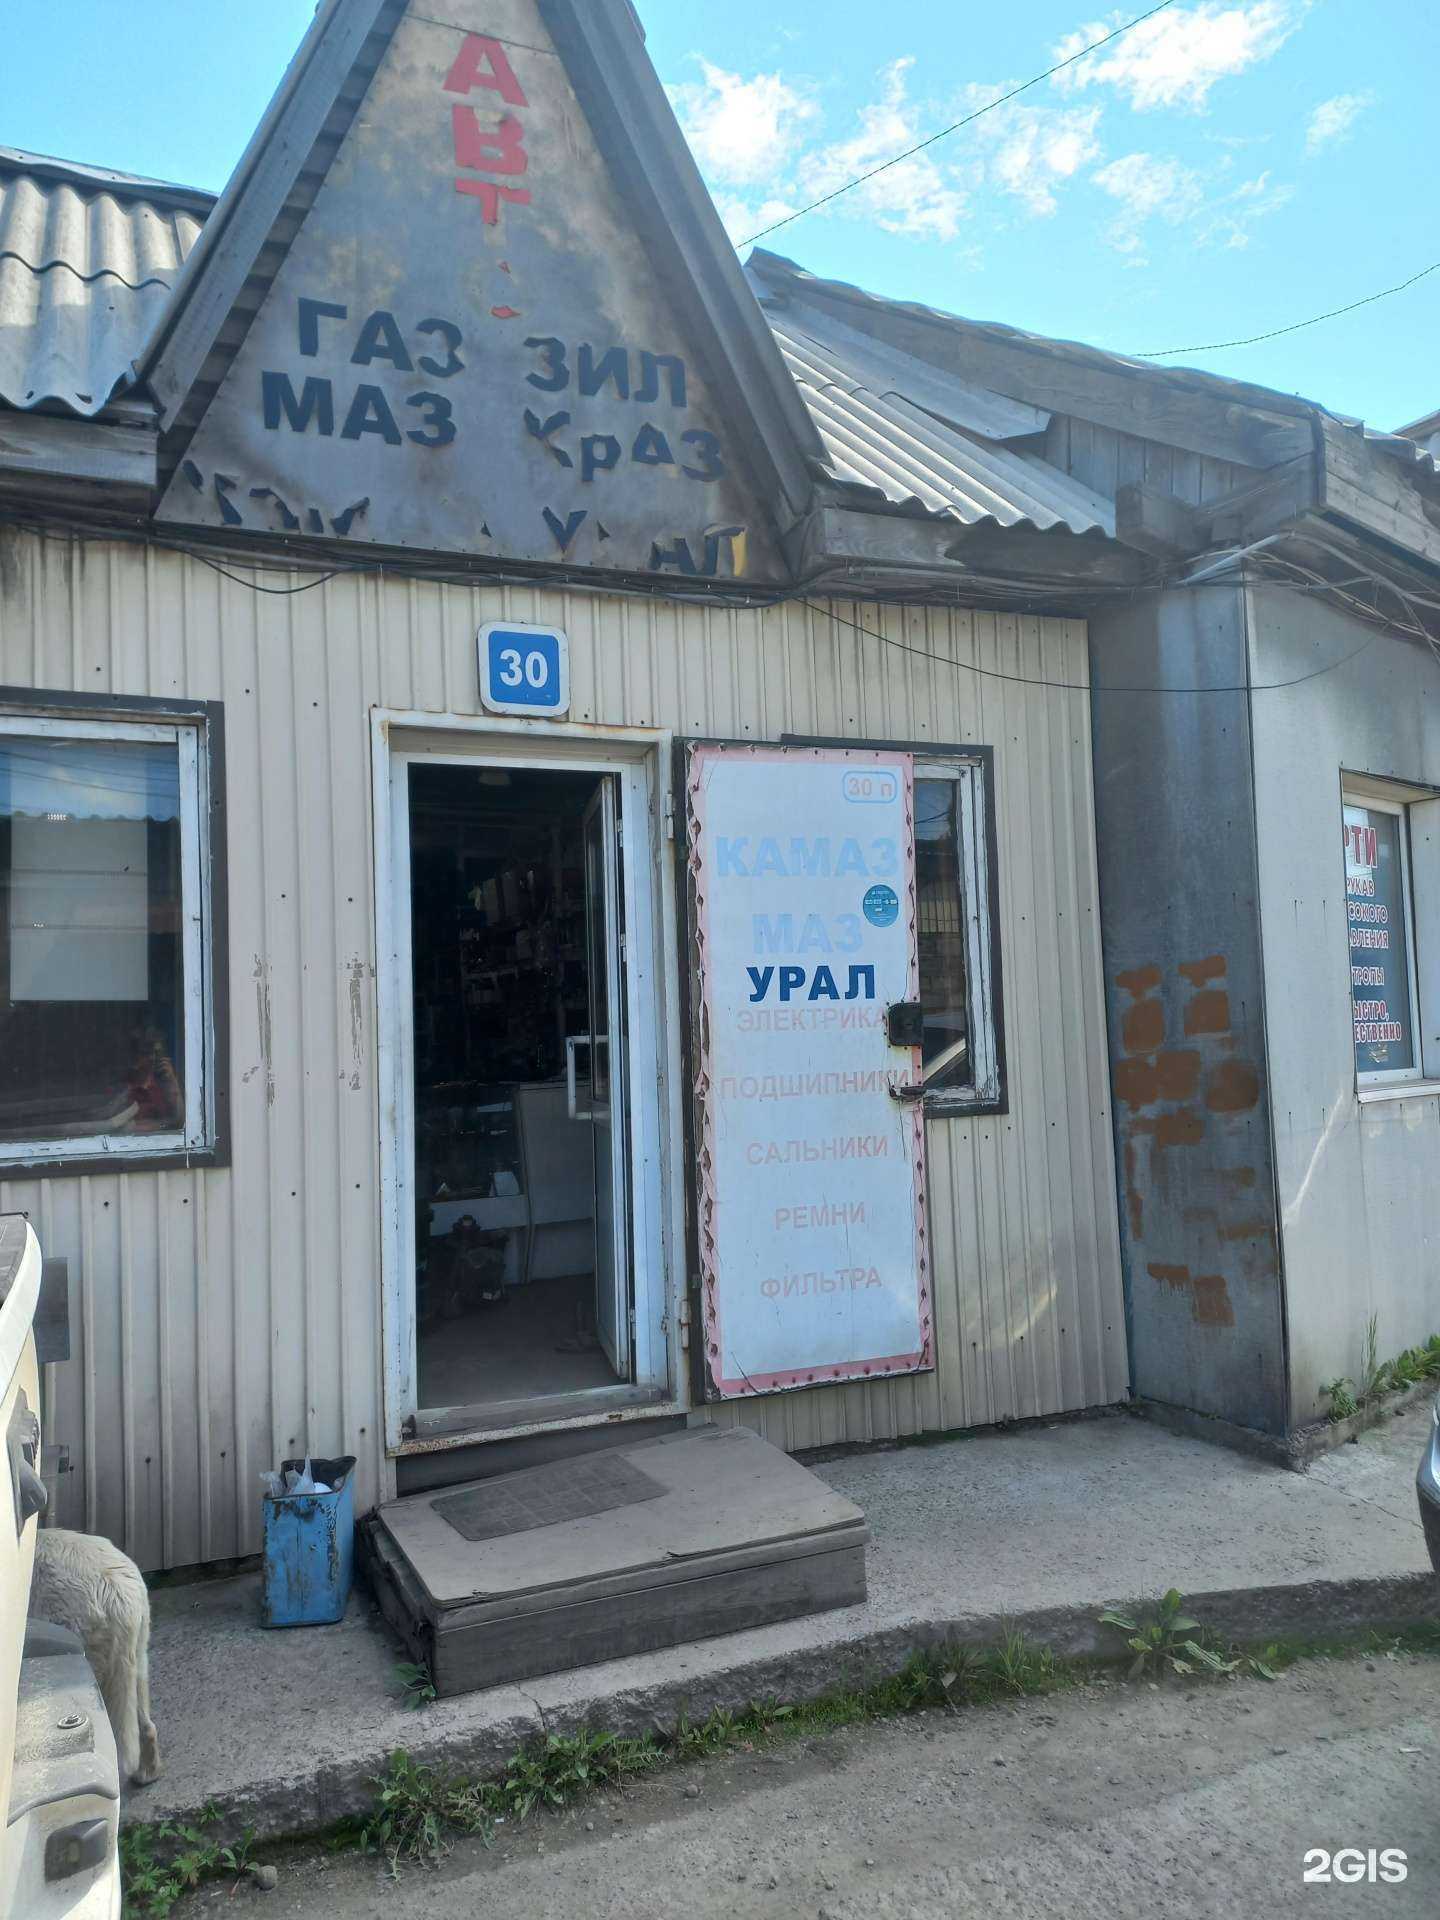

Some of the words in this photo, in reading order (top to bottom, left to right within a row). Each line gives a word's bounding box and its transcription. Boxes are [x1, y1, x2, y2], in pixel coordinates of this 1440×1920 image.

[442, 33, 531, 318] АВТ
[298, 298, 466, 378] ГАЗ
[523, 336, 687, 408] ЗИЛ
[261, 371, 456, 448] МАЗ
[500, 648, 548, 688] 30
[848, 778, 872, 796] 30
[715, 836, 898, 877] КАМАЗ
[751, 913, 864, 954] МАЗ
[746, 964, 875, 1003] УРАЛ
[748, 1135, 889, 1165] САЛЬНИКИ
[774, 1202, 866, 1230] РЕМНИ
[759, 1267, 882, 1298] ФИЛЬТРА
